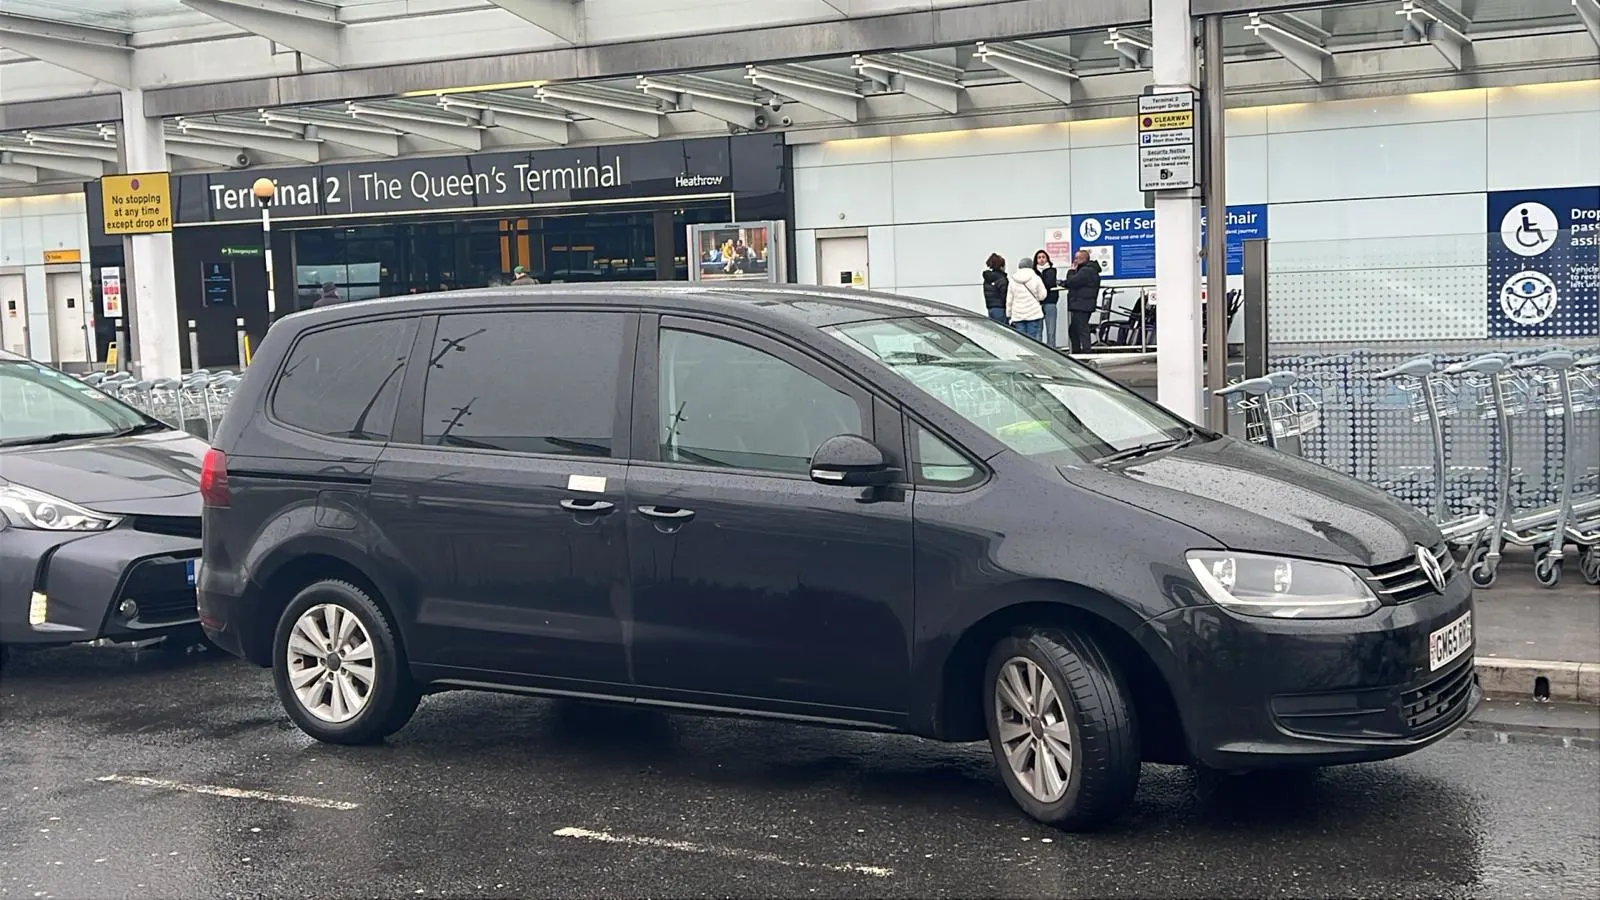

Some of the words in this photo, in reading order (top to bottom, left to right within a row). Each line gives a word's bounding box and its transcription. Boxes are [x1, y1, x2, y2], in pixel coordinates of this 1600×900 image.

[1154, 115, 1190, 123] CLEARWAY
[359, 171, 402, 201] The
[410, 165, 507, 202] Queen's
[513, 155, 621, 192] Terminal
[675, 174, 723, 188] Heathrow
[326, 176, 341, 203] 2
[112, 195, 124, 205] No
[125, 193, 161, 205] stopping
[114, 207, 123, 217] at
[125, 208, 139, 217] any
[141, 206, 160, 216] time
[106, 220, 134, 230] except
[135, 217, 155, 229] drop
[157, 216, 169, 226] off
[1104, 217, 1131, 232] Self
[1436, 626, 1457, 663] GM65
